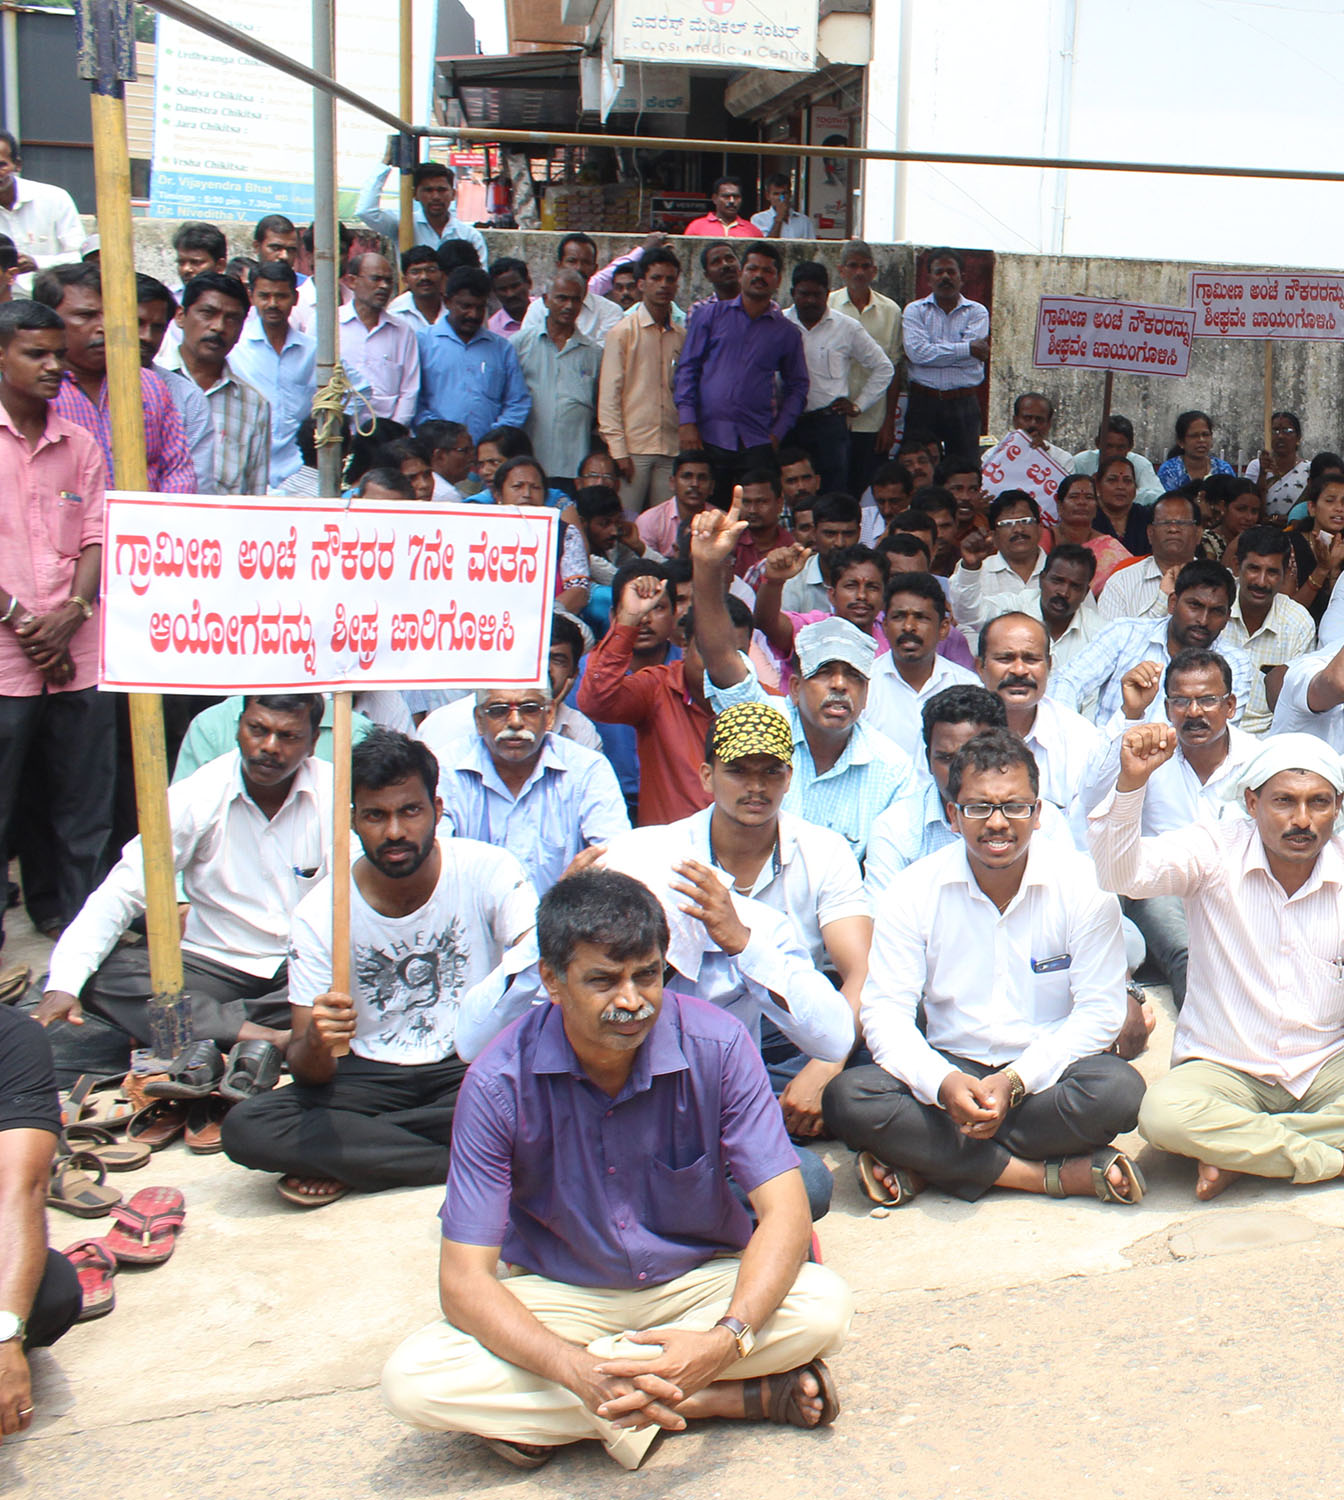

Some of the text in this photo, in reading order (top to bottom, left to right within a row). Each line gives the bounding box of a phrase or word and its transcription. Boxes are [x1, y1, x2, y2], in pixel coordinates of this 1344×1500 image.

[178, 176, 242, 192] Vijayendra
[245, 182, 273, 194] Bhat
[177, 206, 235, 220] Niveditha
[1196, 282, 1243, 306] ಗ್ರಾಮೀಣ
[1249, 280, 1278, 300] ಅಂಚೆ
[1042, 308, 1190, 347] ಗ್ರಾಮೀಣ ಅಂಚೆ ನೌಕರರನ್ನು
[1204, 307, 1247, 334] ಶೀಘ್ರವೇ
[1047, 334, 1087, 362] ಶೀಘ್ರವೇ
[115, 524, 539, 596] ಗ್ರಾಮೀಣ ಅಂಚೆ ನೌಕರರ 7ನೇ ವೇತನ
[150, 599, 515, 675] ಆಯೋಗವನ್ನು ಶೀಘ್ರ ಜಾರಿಗೊಳಿಸಿ
